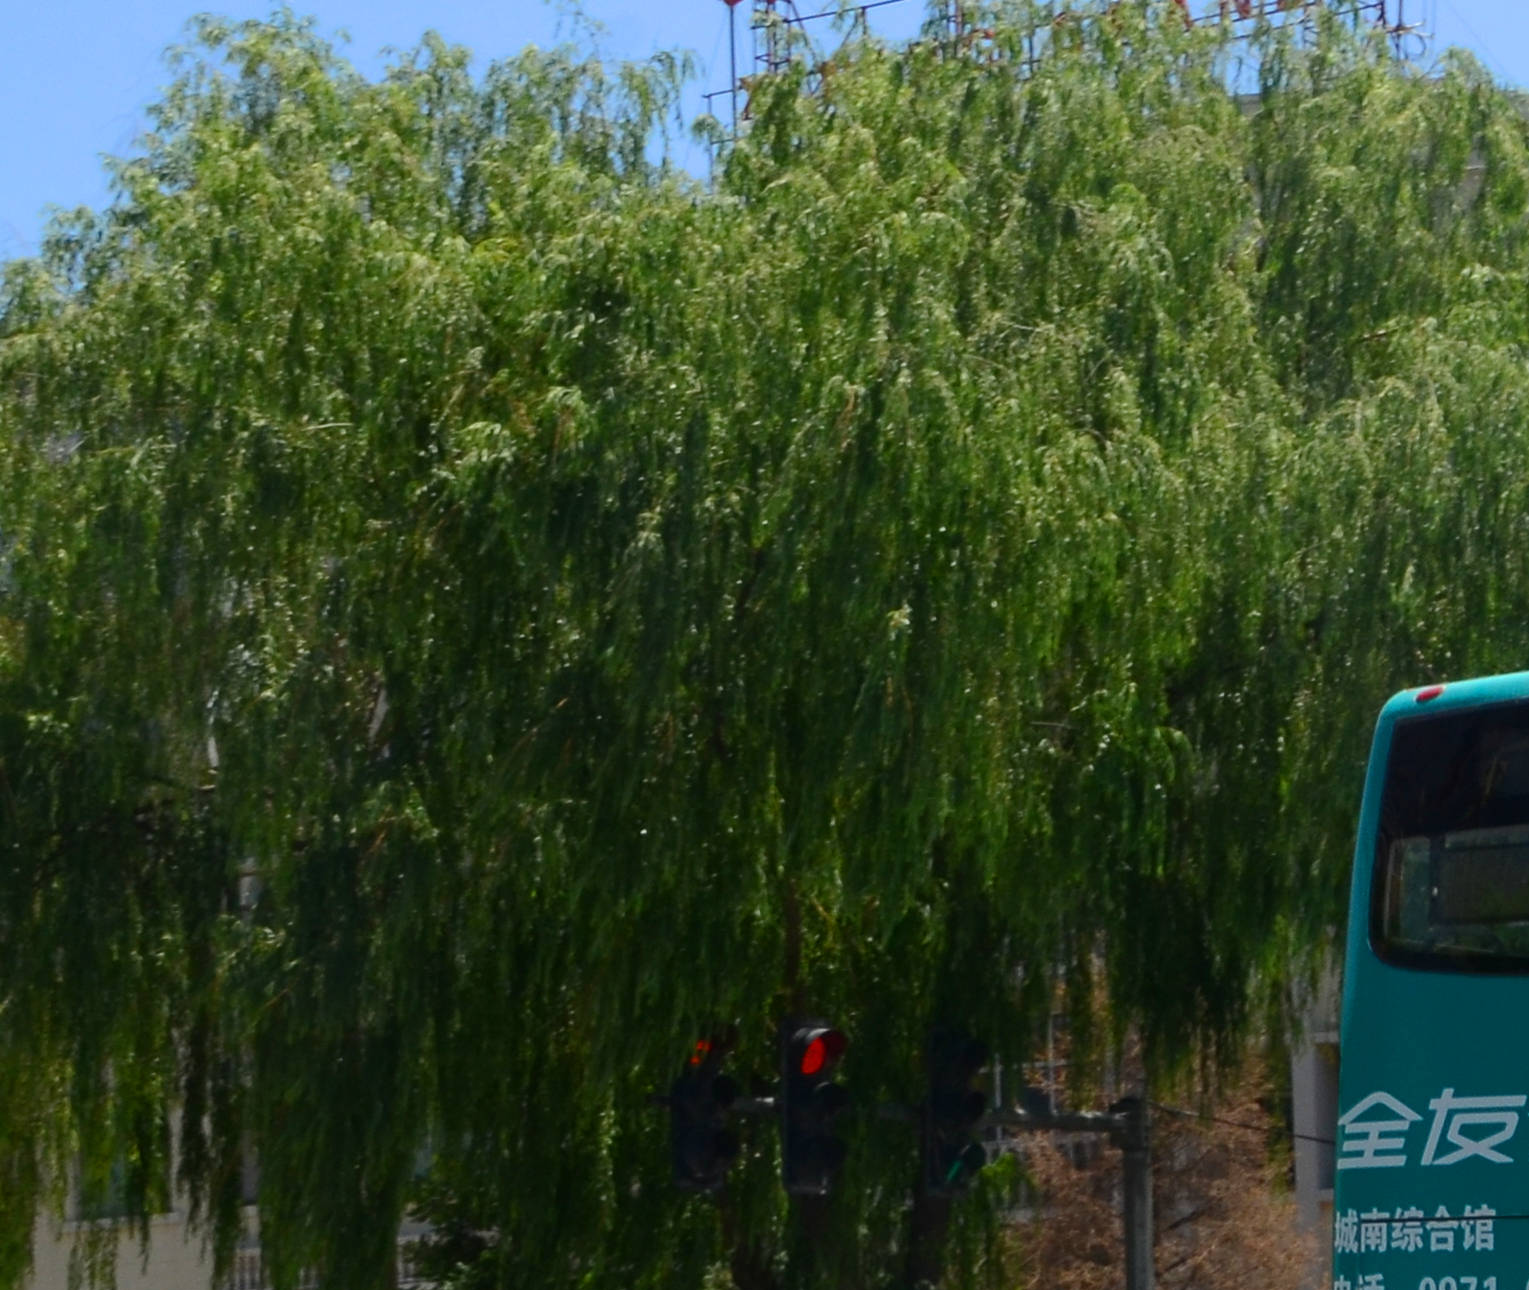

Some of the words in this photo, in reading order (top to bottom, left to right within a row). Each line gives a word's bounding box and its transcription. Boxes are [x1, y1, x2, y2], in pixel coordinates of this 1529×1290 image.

[1334, 1204, 1496, 1253] 城南综合馆
